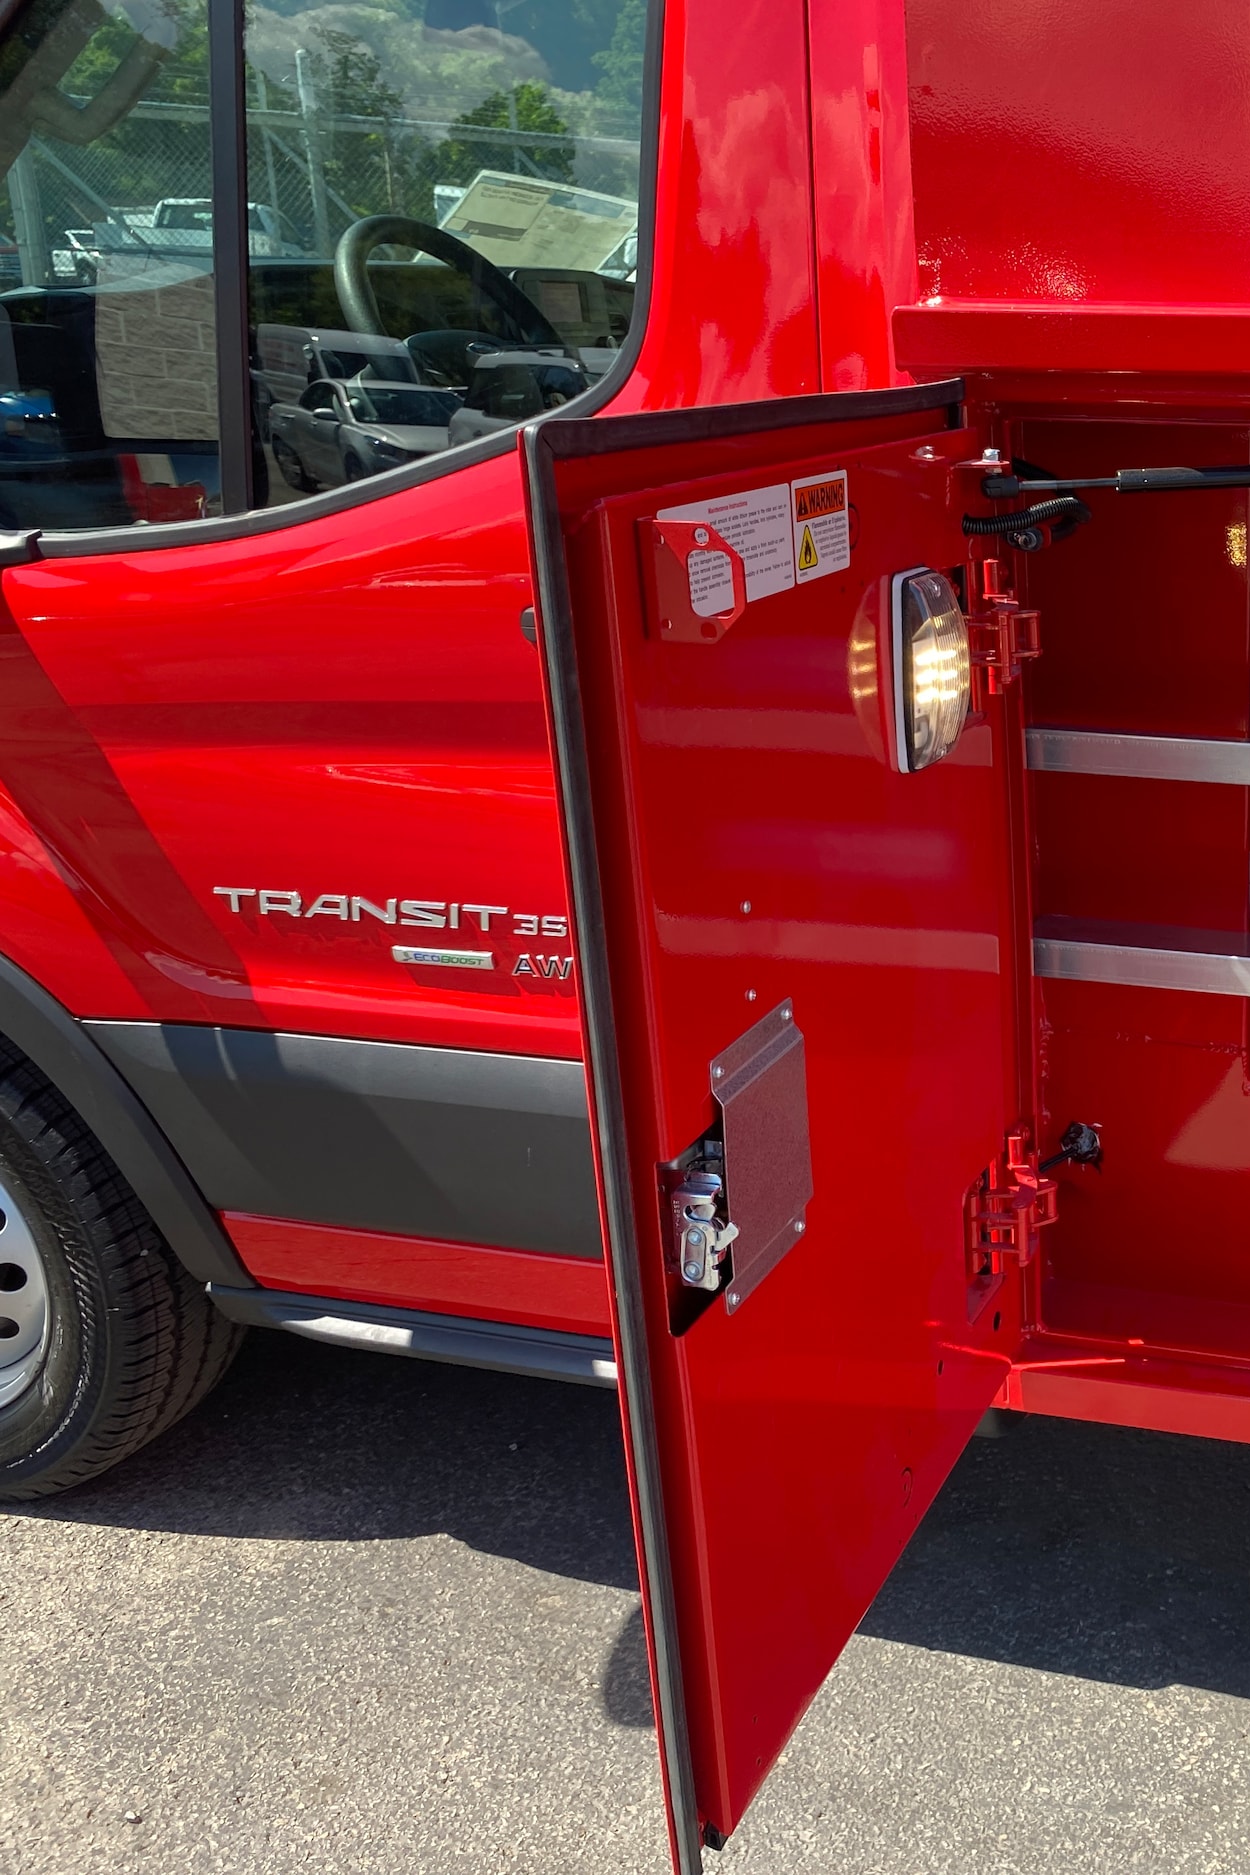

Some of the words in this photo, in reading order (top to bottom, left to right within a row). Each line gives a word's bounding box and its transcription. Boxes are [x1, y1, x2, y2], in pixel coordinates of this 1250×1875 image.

[808, 483, 844, 513] WARNING
[213, 886, 508, 931] TRANSIT
[413, 953, 484, 966] ECOBOOST
